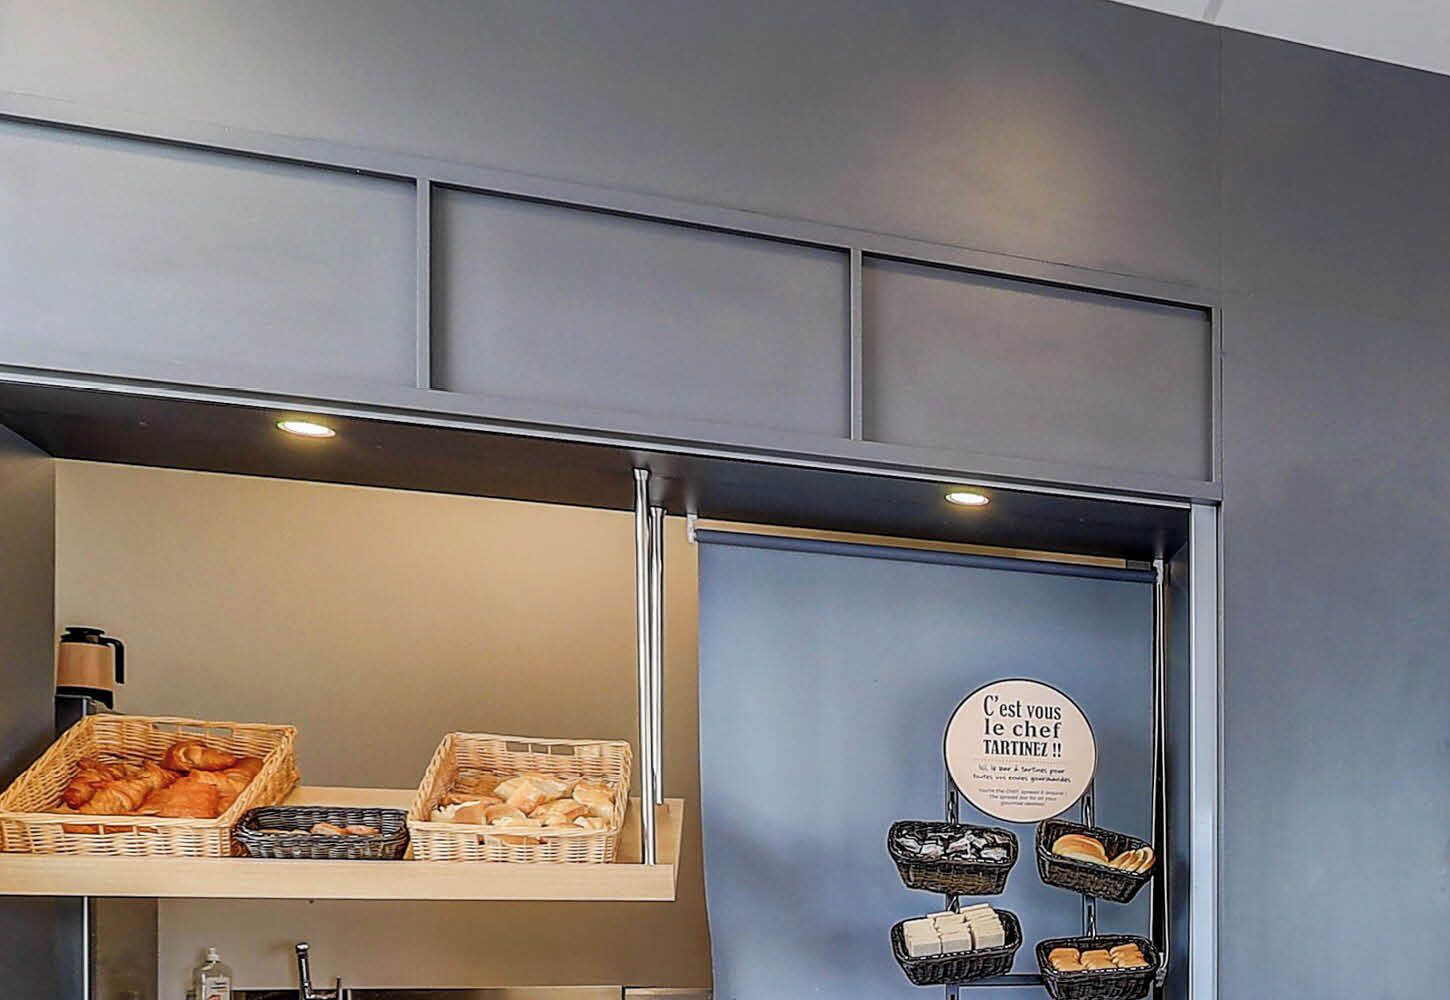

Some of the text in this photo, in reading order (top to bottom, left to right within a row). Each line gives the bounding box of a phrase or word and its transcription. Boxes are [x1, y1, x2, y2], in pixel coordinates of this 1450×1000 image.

[983, 694, 1062, 721] C'est vous
[984, 718, 1062, 739] le chef
[983, 739, 1048, 757] TARTINEZ
